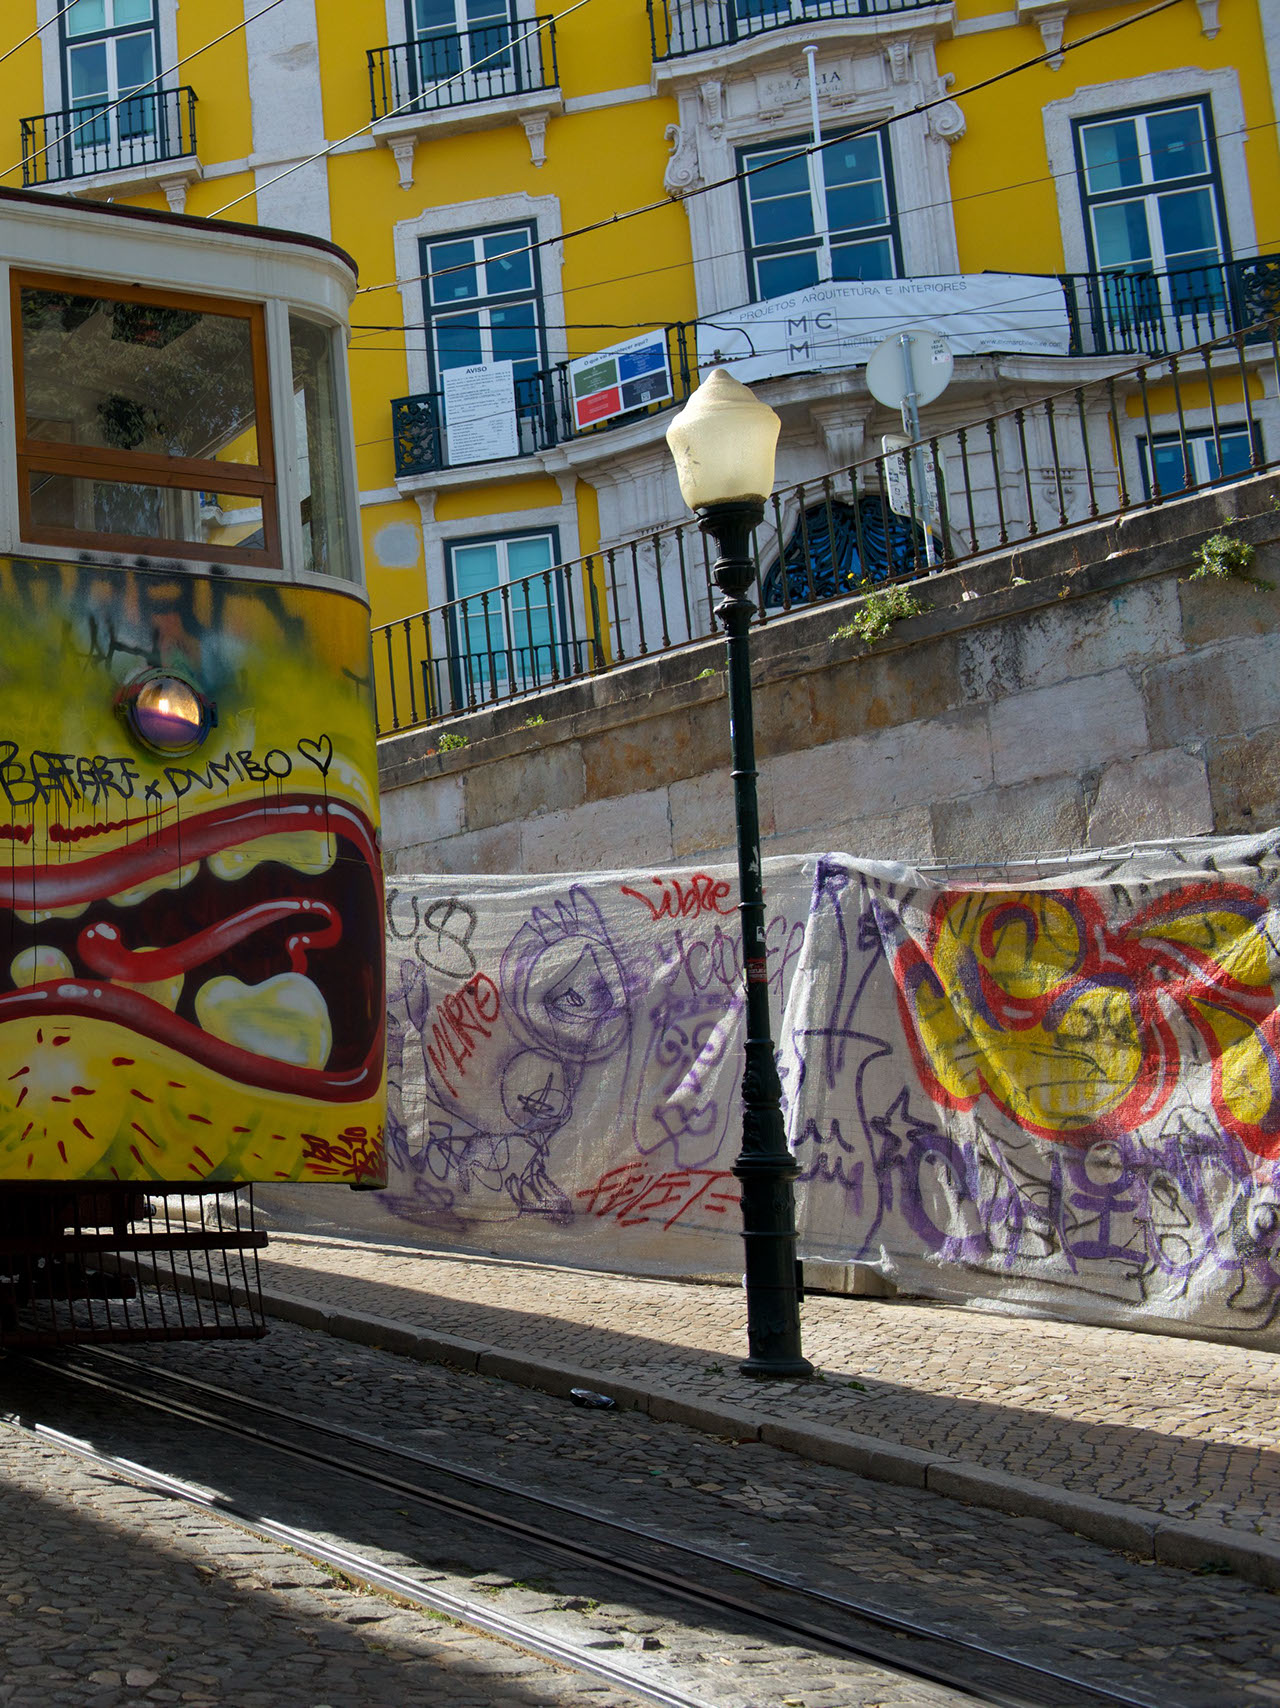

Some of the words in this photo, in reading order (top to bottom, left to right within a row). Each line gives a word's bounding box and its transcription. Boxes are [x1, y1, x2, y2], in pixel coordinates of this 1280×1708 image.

[739, 299, 796, 322] PROJETOS
[801, 285, 881, 305] ARQUITETURA
[885, 285, 893, 296] E
[899, 280, 968, 294] INTERIORES
[465, 365, 488, 375] AVISO
